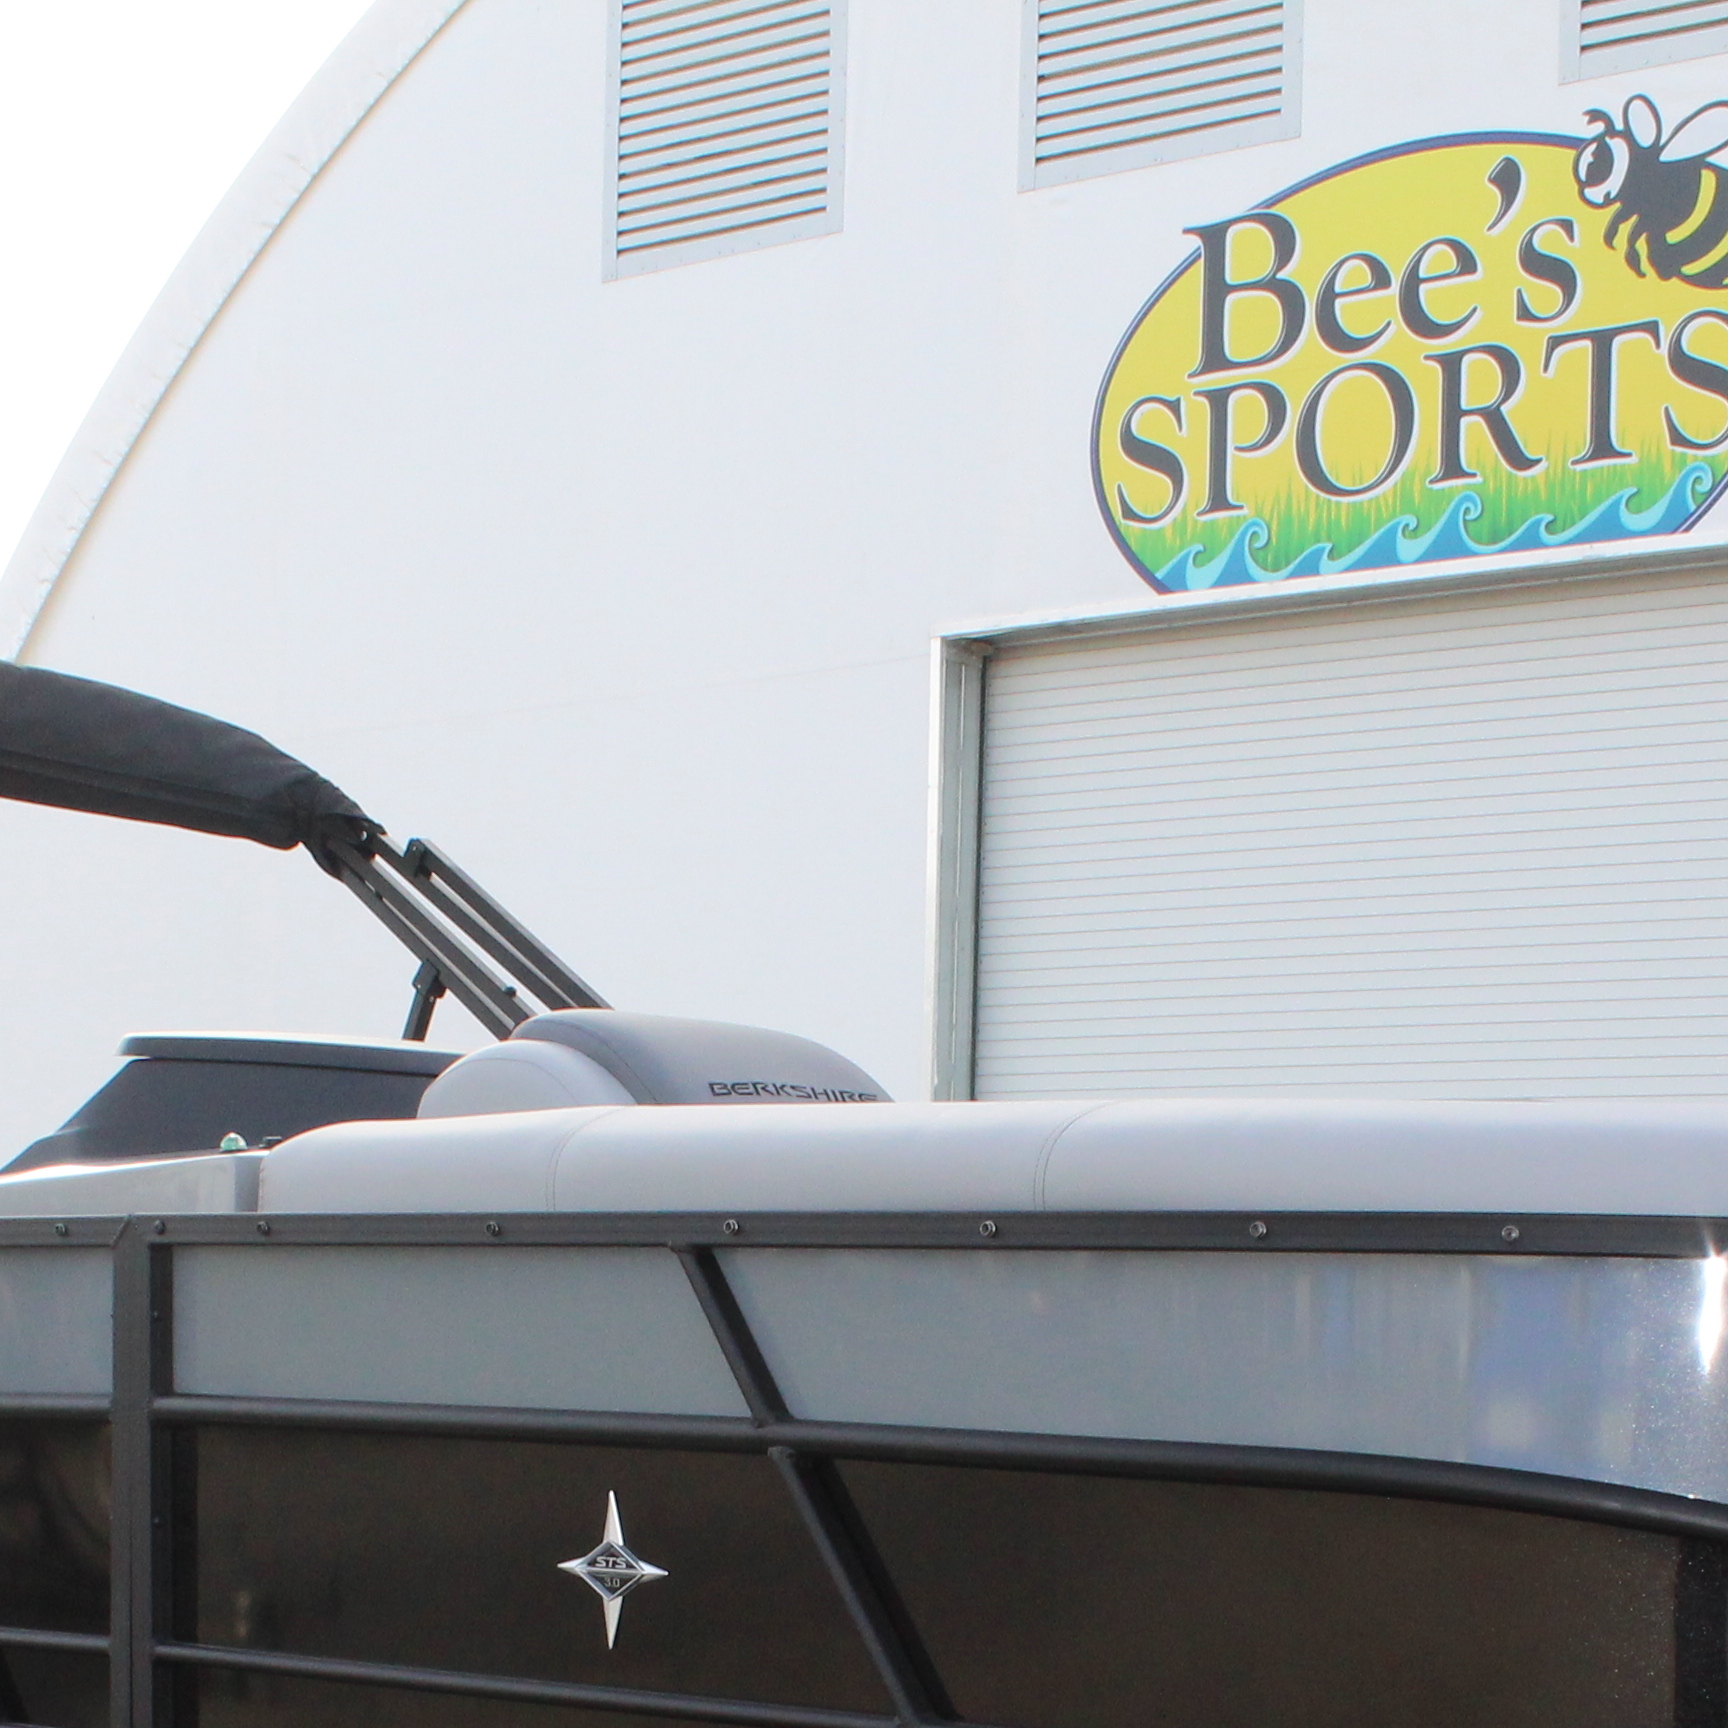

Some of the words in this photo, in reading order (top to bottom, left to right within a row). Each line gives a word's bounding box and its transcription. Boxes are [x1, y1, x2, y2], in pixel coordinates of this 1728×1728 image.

[1182, 155, 1581, 381] Bee's
[596, 1556, 626, 1568] STS
[604, 1578, 620, 1587] 3.0
